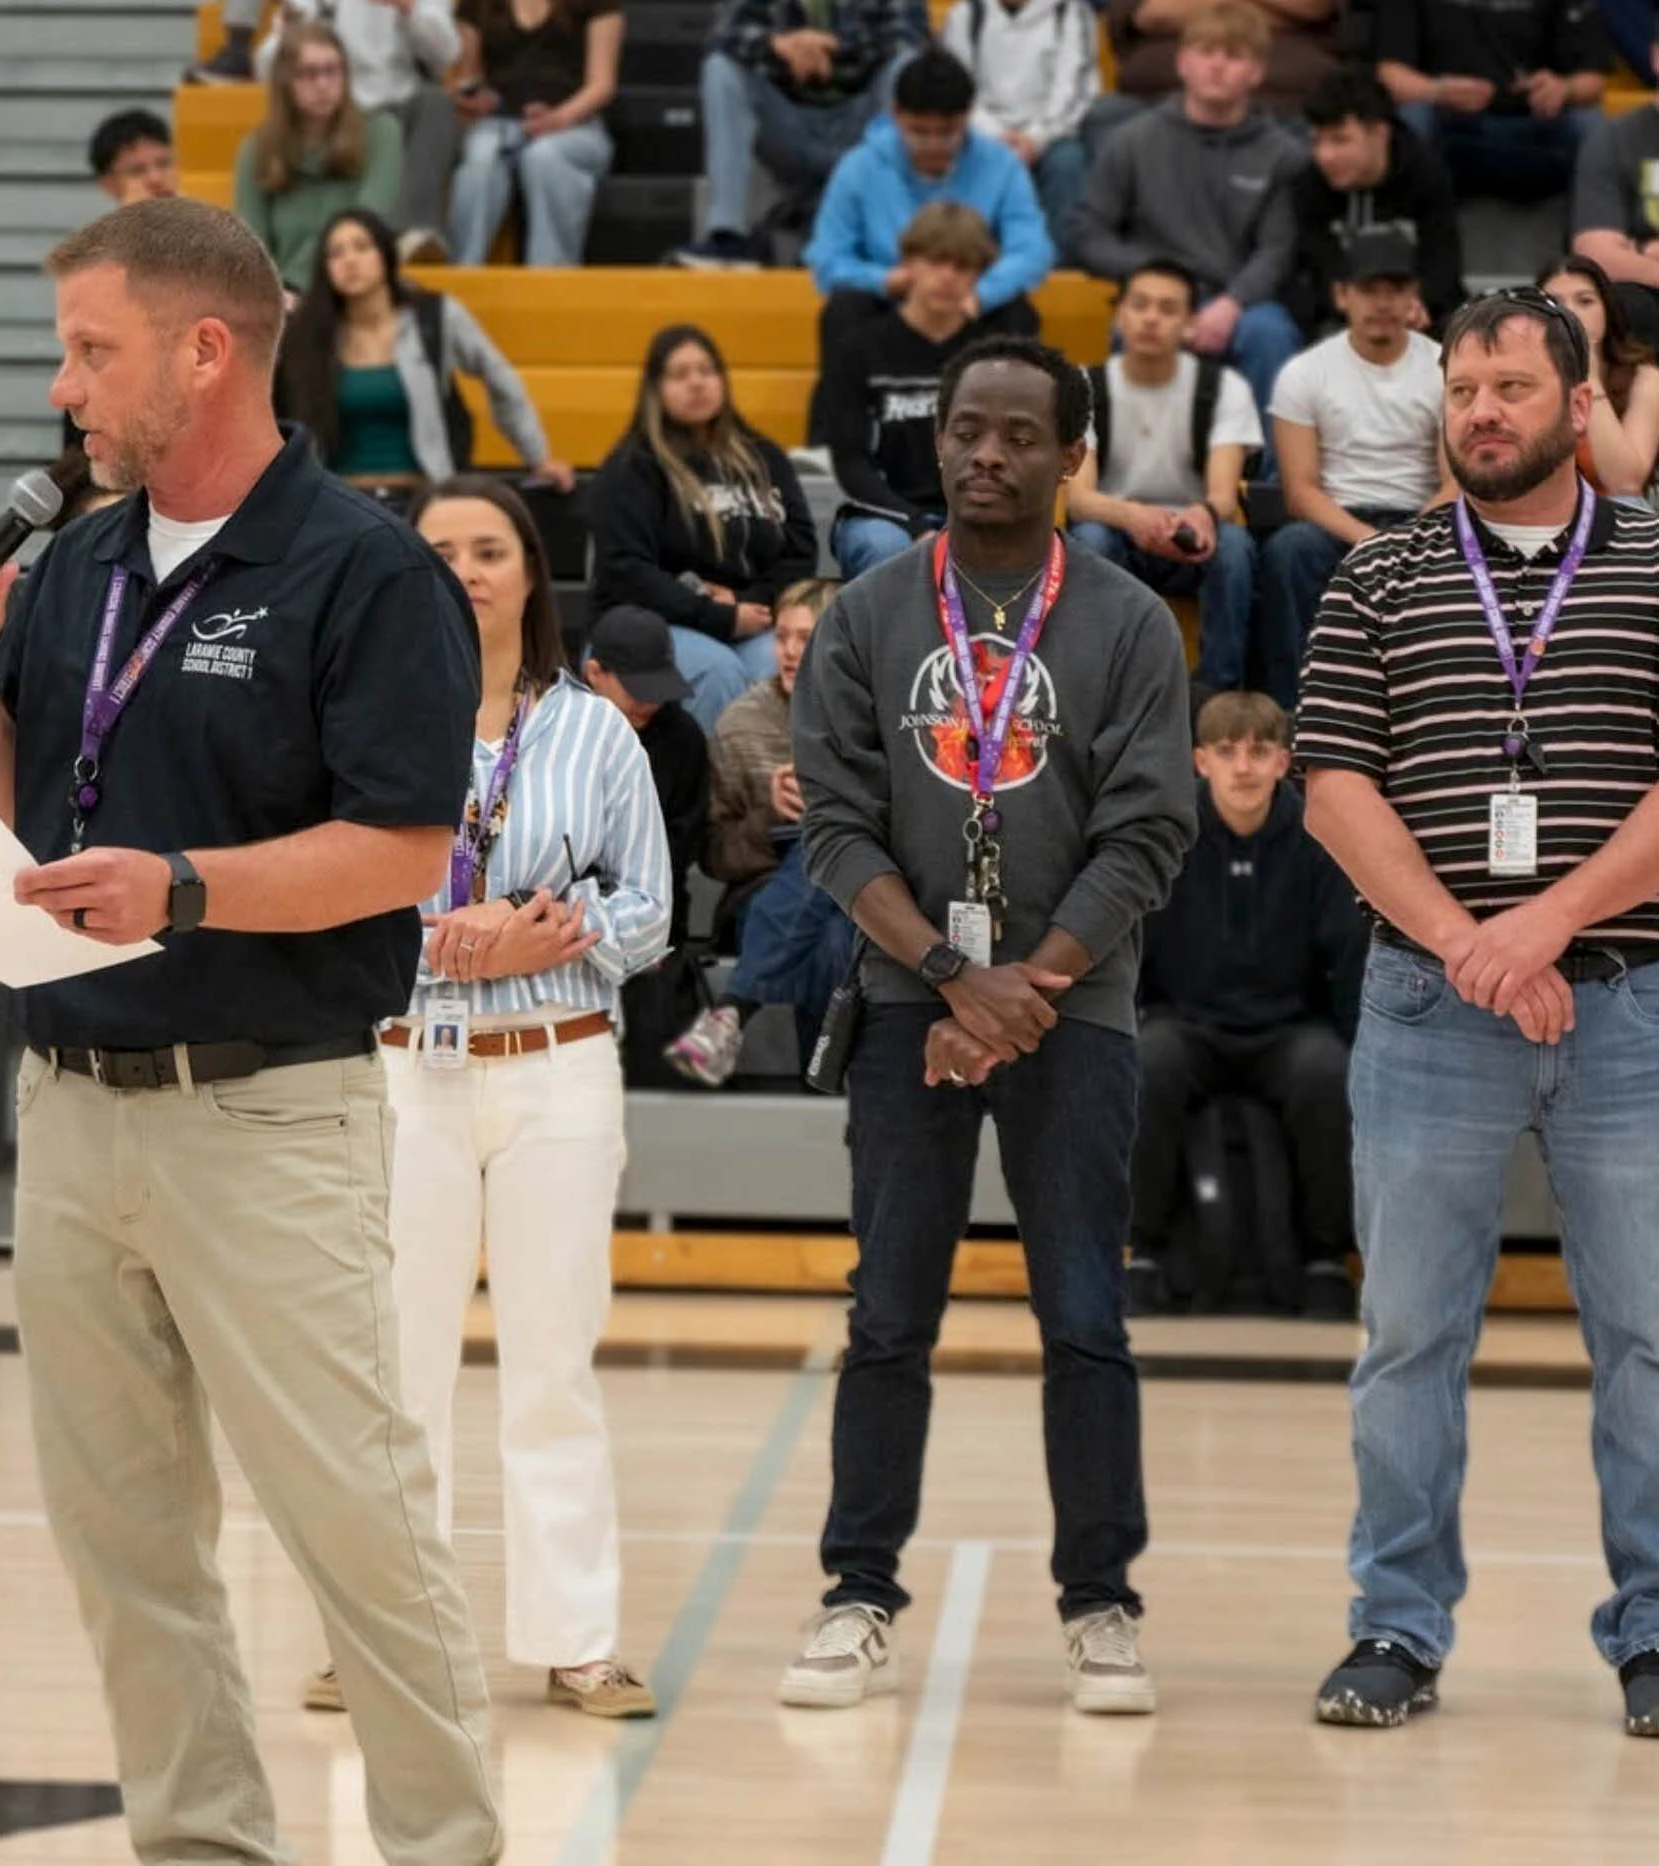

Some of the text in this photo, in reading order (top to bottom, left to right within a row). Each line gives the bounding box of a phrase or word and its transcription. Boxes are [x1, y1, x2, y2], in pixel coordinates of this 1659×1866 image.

[185, 641, 257, 665] LARAMIE COUNTY
[181, 658, 211, 673] SCHOOL
[210, 660, 248, 678] DISTRICT
[898, 713, 959, 731] JOHNSON
